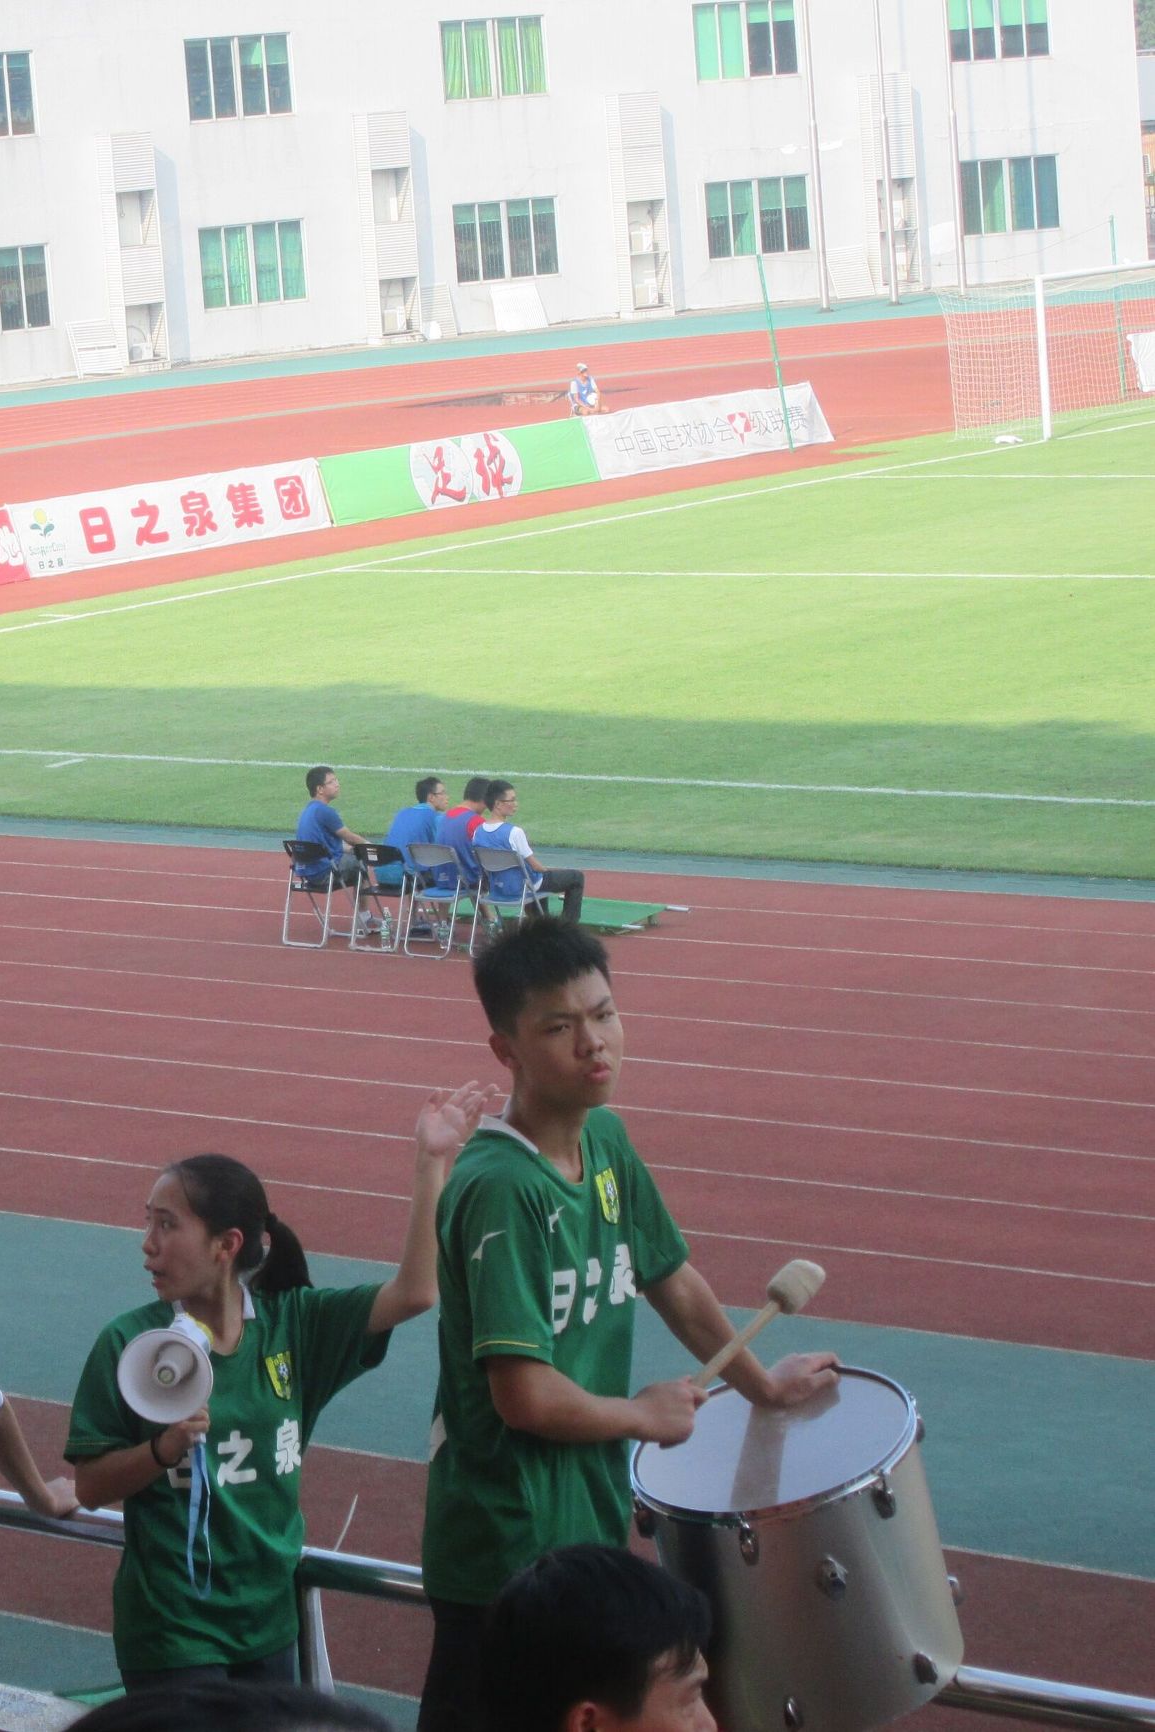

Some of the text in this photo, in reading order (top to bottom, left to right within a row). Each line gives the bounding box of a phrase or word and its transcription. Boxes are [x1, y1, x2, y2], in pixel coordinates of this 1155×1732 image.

[79, 474, 311, 555] 日之泉集团
